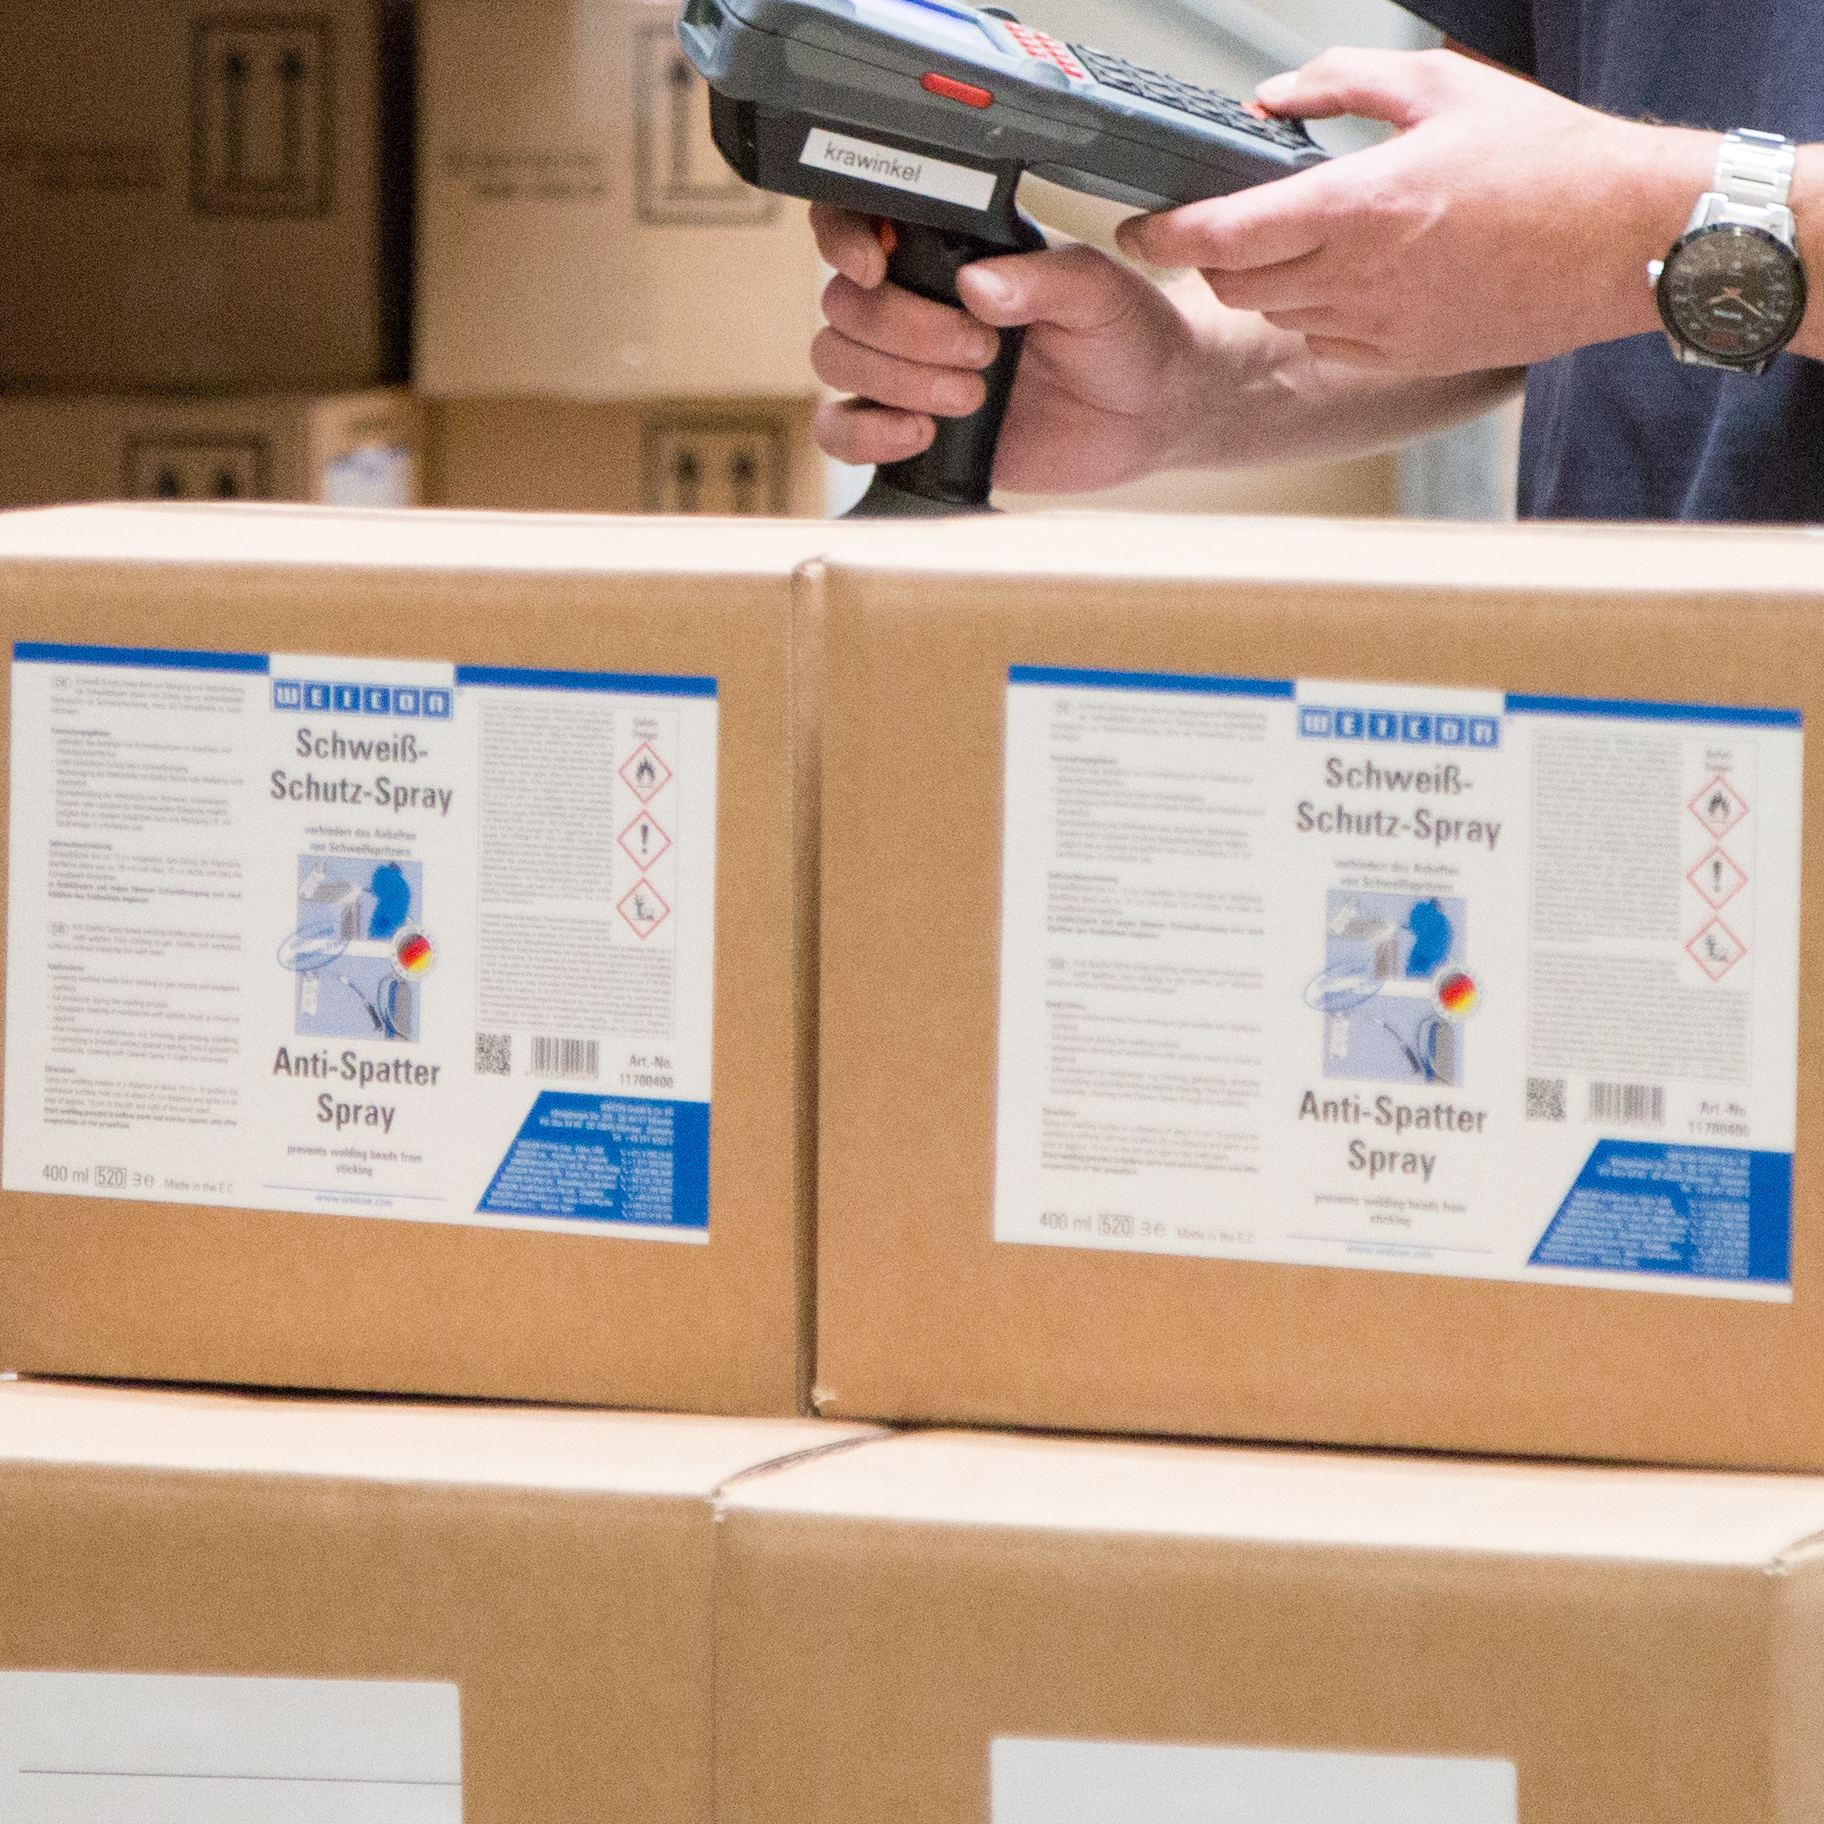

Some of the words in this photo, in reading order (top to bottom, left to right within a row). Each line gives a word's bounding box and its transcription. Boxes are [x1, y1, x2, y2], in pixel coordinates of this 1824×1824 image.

[823, 141, 924, 184] krawinkel
[272, 679, 454, 721] WEICON
[295, 727, 428, 766] Schweiß-
[270, 770, 453, 816] Schutz-Spray
[1325, 756, 1474, 797] Schweiß-
[1296, 801, 1502, 852] Schutz-Spray
[273, 1047, 441, 1089] Anti-Spatter
[317, 1094, 396, 1134] Spray
[1298, 1089, 1488, 1135] Anti-Spatter
[42, 1164, 68, 1183] 400
[72, 1167, 89, 1184] ml
[98, 1168, 124, 1187] 520
[1348, 1139, 1436, 1182] Spray
[1039, 1212, 1068, 1231] 400
